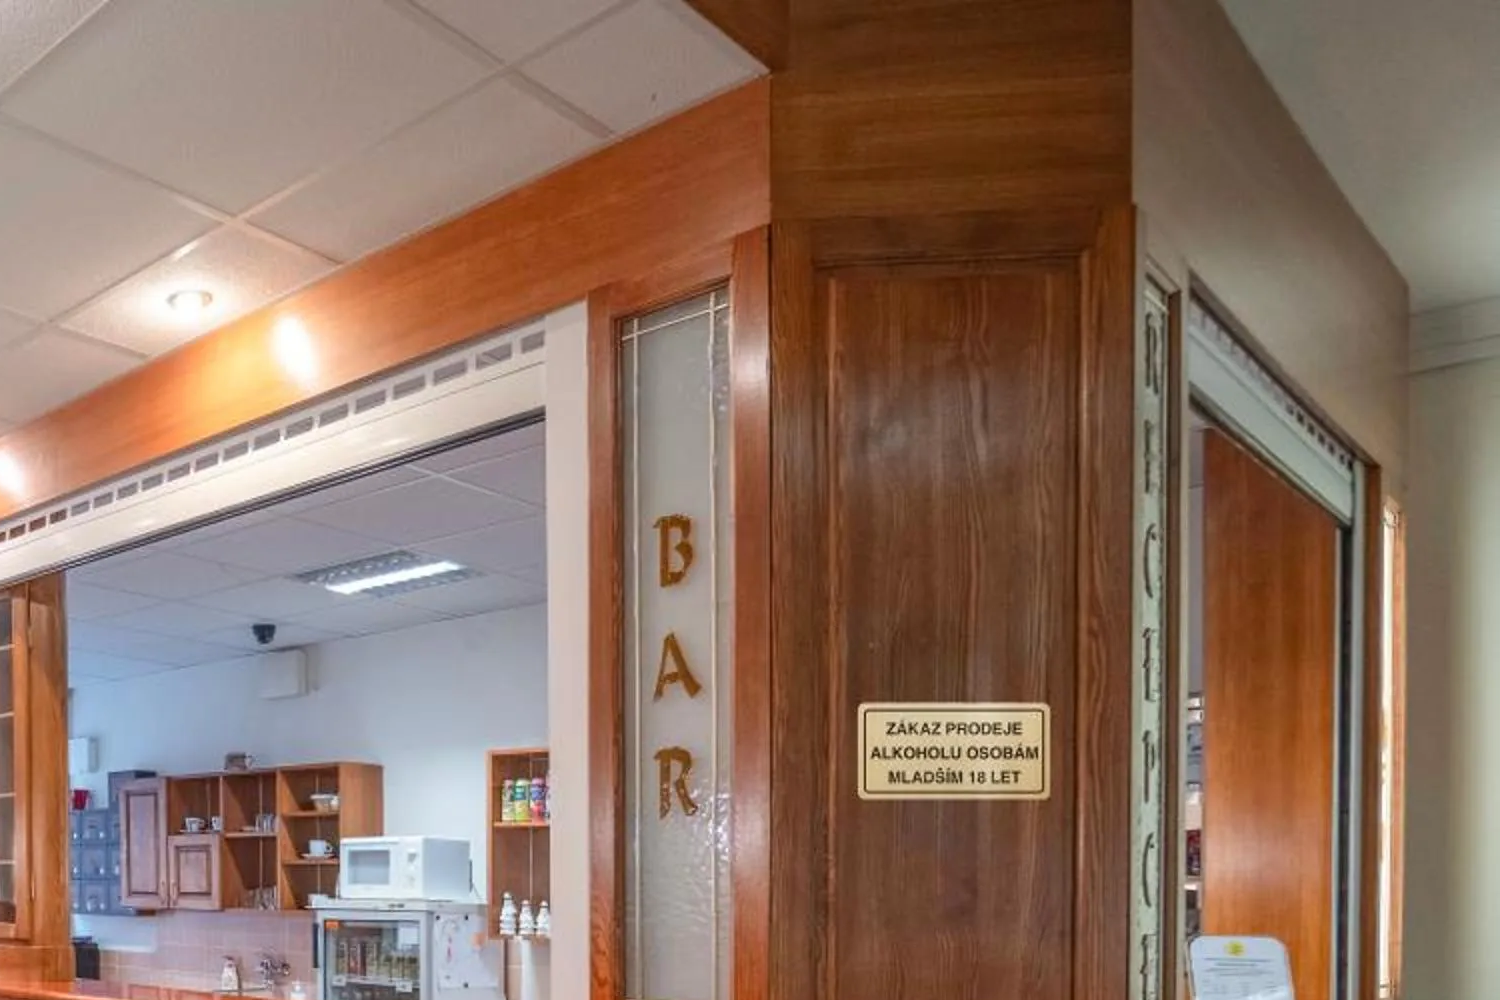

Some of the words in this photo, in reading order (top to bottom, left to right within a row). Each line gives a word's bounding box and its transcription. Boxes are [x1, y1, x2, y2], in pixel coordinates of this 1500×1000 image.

[653, 513, 702, 819] BAR
[885, 718, 942, 736] ZÁKAZ
[945, 721, 1023, 736] PRODEJE
[870, 746, 961, 760] ALKOHOLU
[966, 743, 1039, 760] OSOBÁM
[888, 767, 963, 785] MLADŠÍM
[970, 770, 987, 785] 18
[991, 770, 1022, 785] LET
